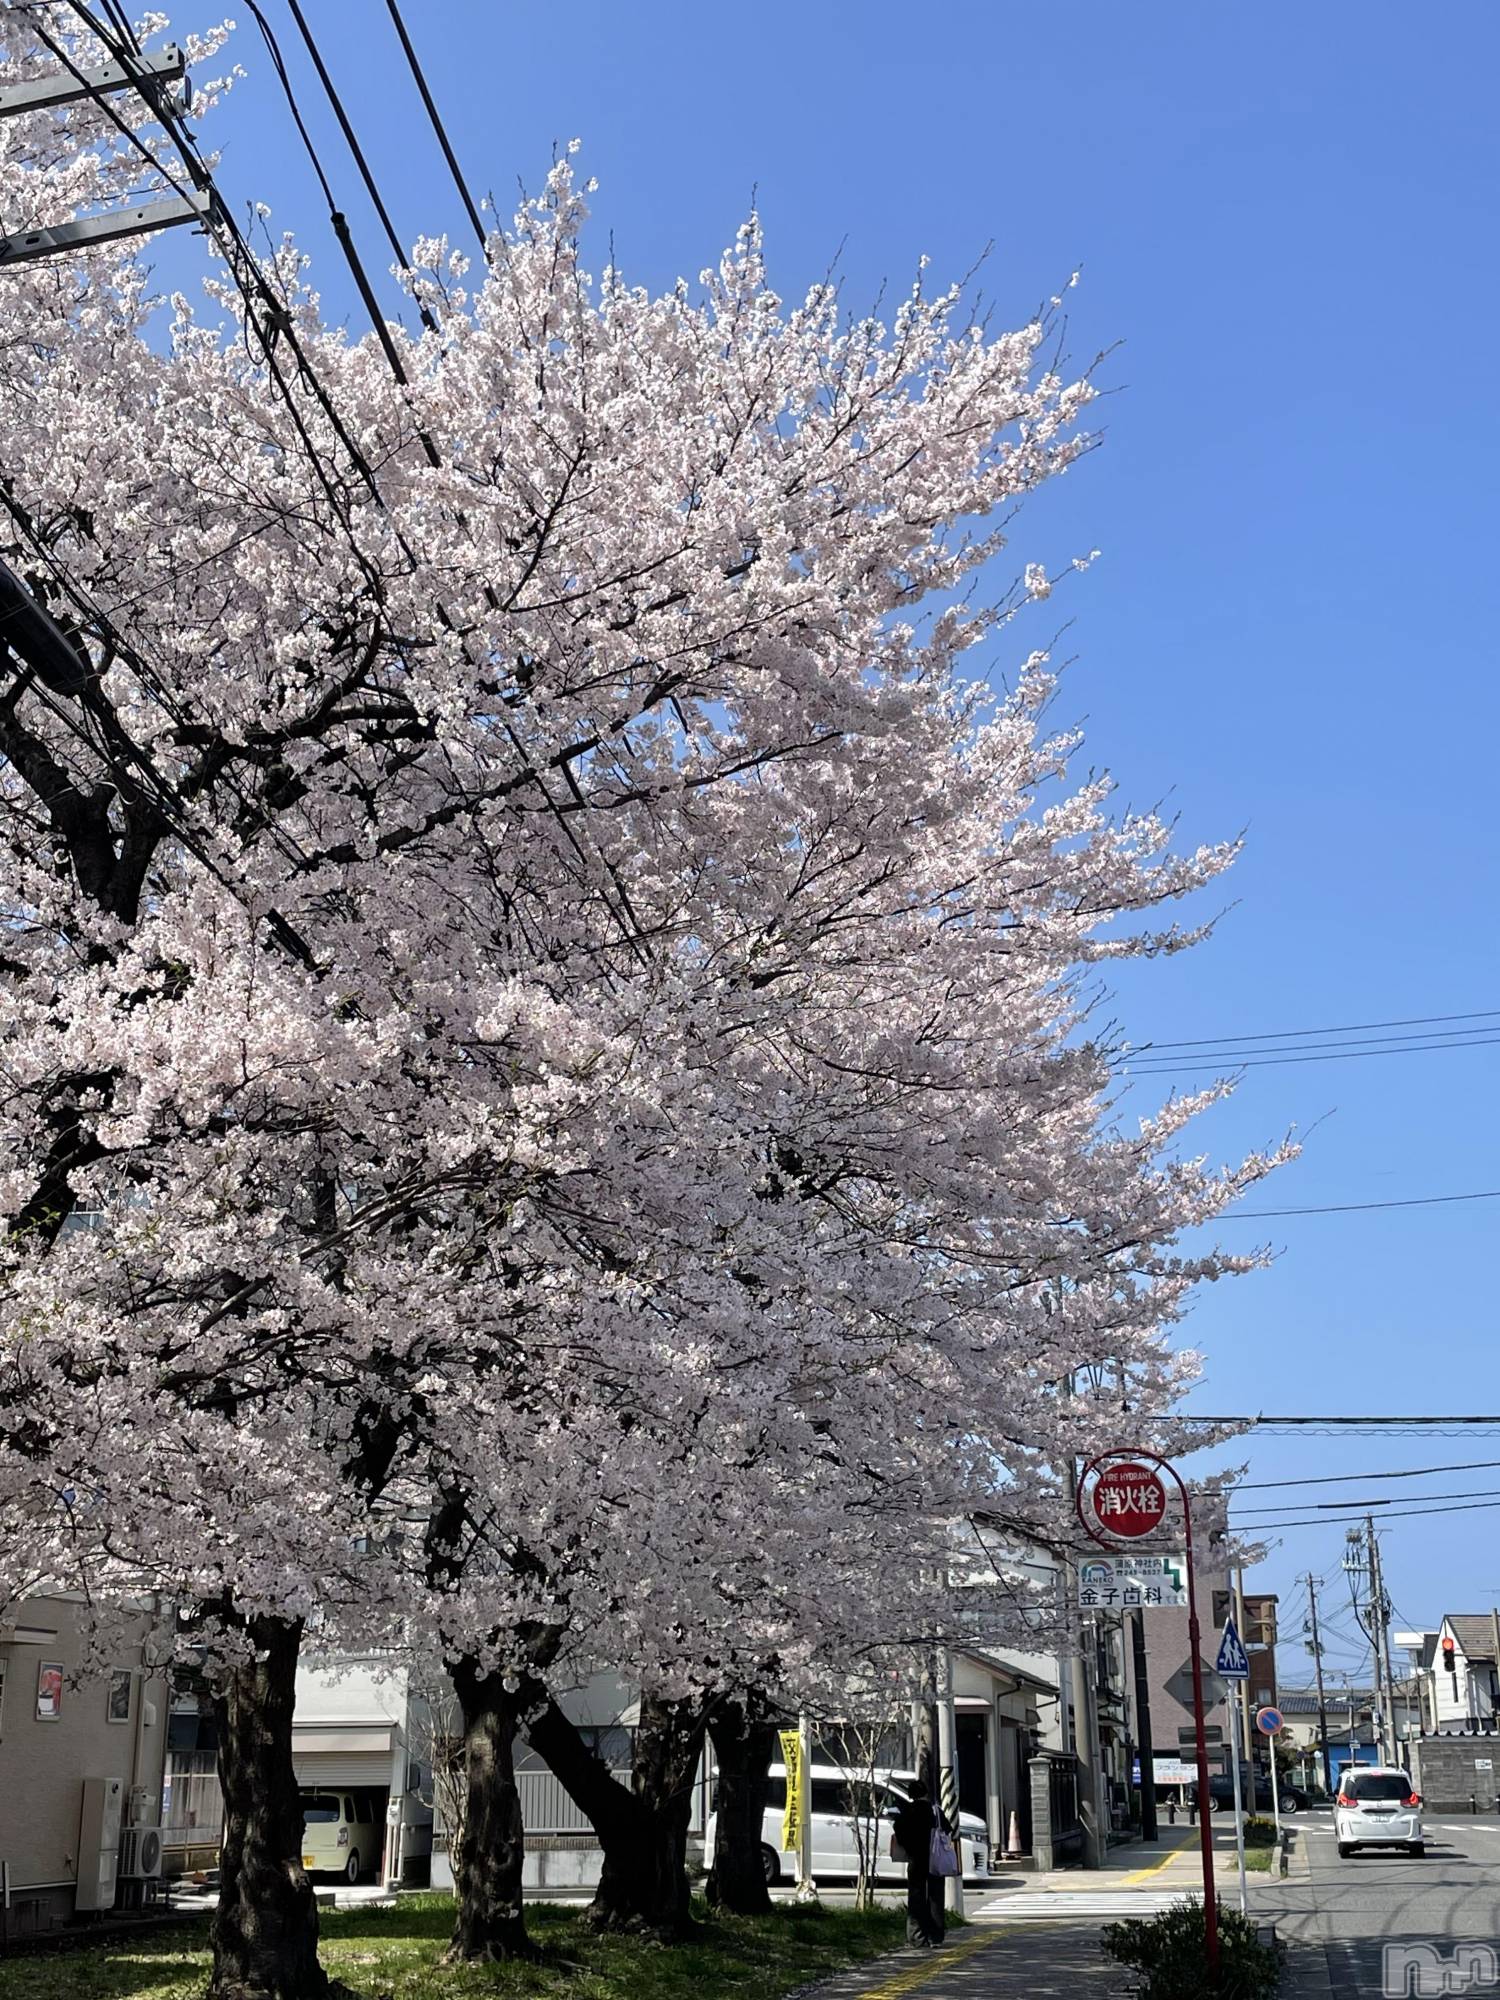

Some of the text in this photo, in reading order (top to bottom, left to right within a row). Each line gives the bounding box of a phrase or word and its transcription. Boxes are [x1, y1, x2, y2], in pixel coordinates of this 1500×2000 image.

[1103, 1471, 1152, 1482] FIRE HYDRANT
[1098, 1484, 1161, 1516] 消火栓
[1081, 1576, 1114, 1584] KANEKO
[1080, 1586, 1162, 1606] 金子歯科
